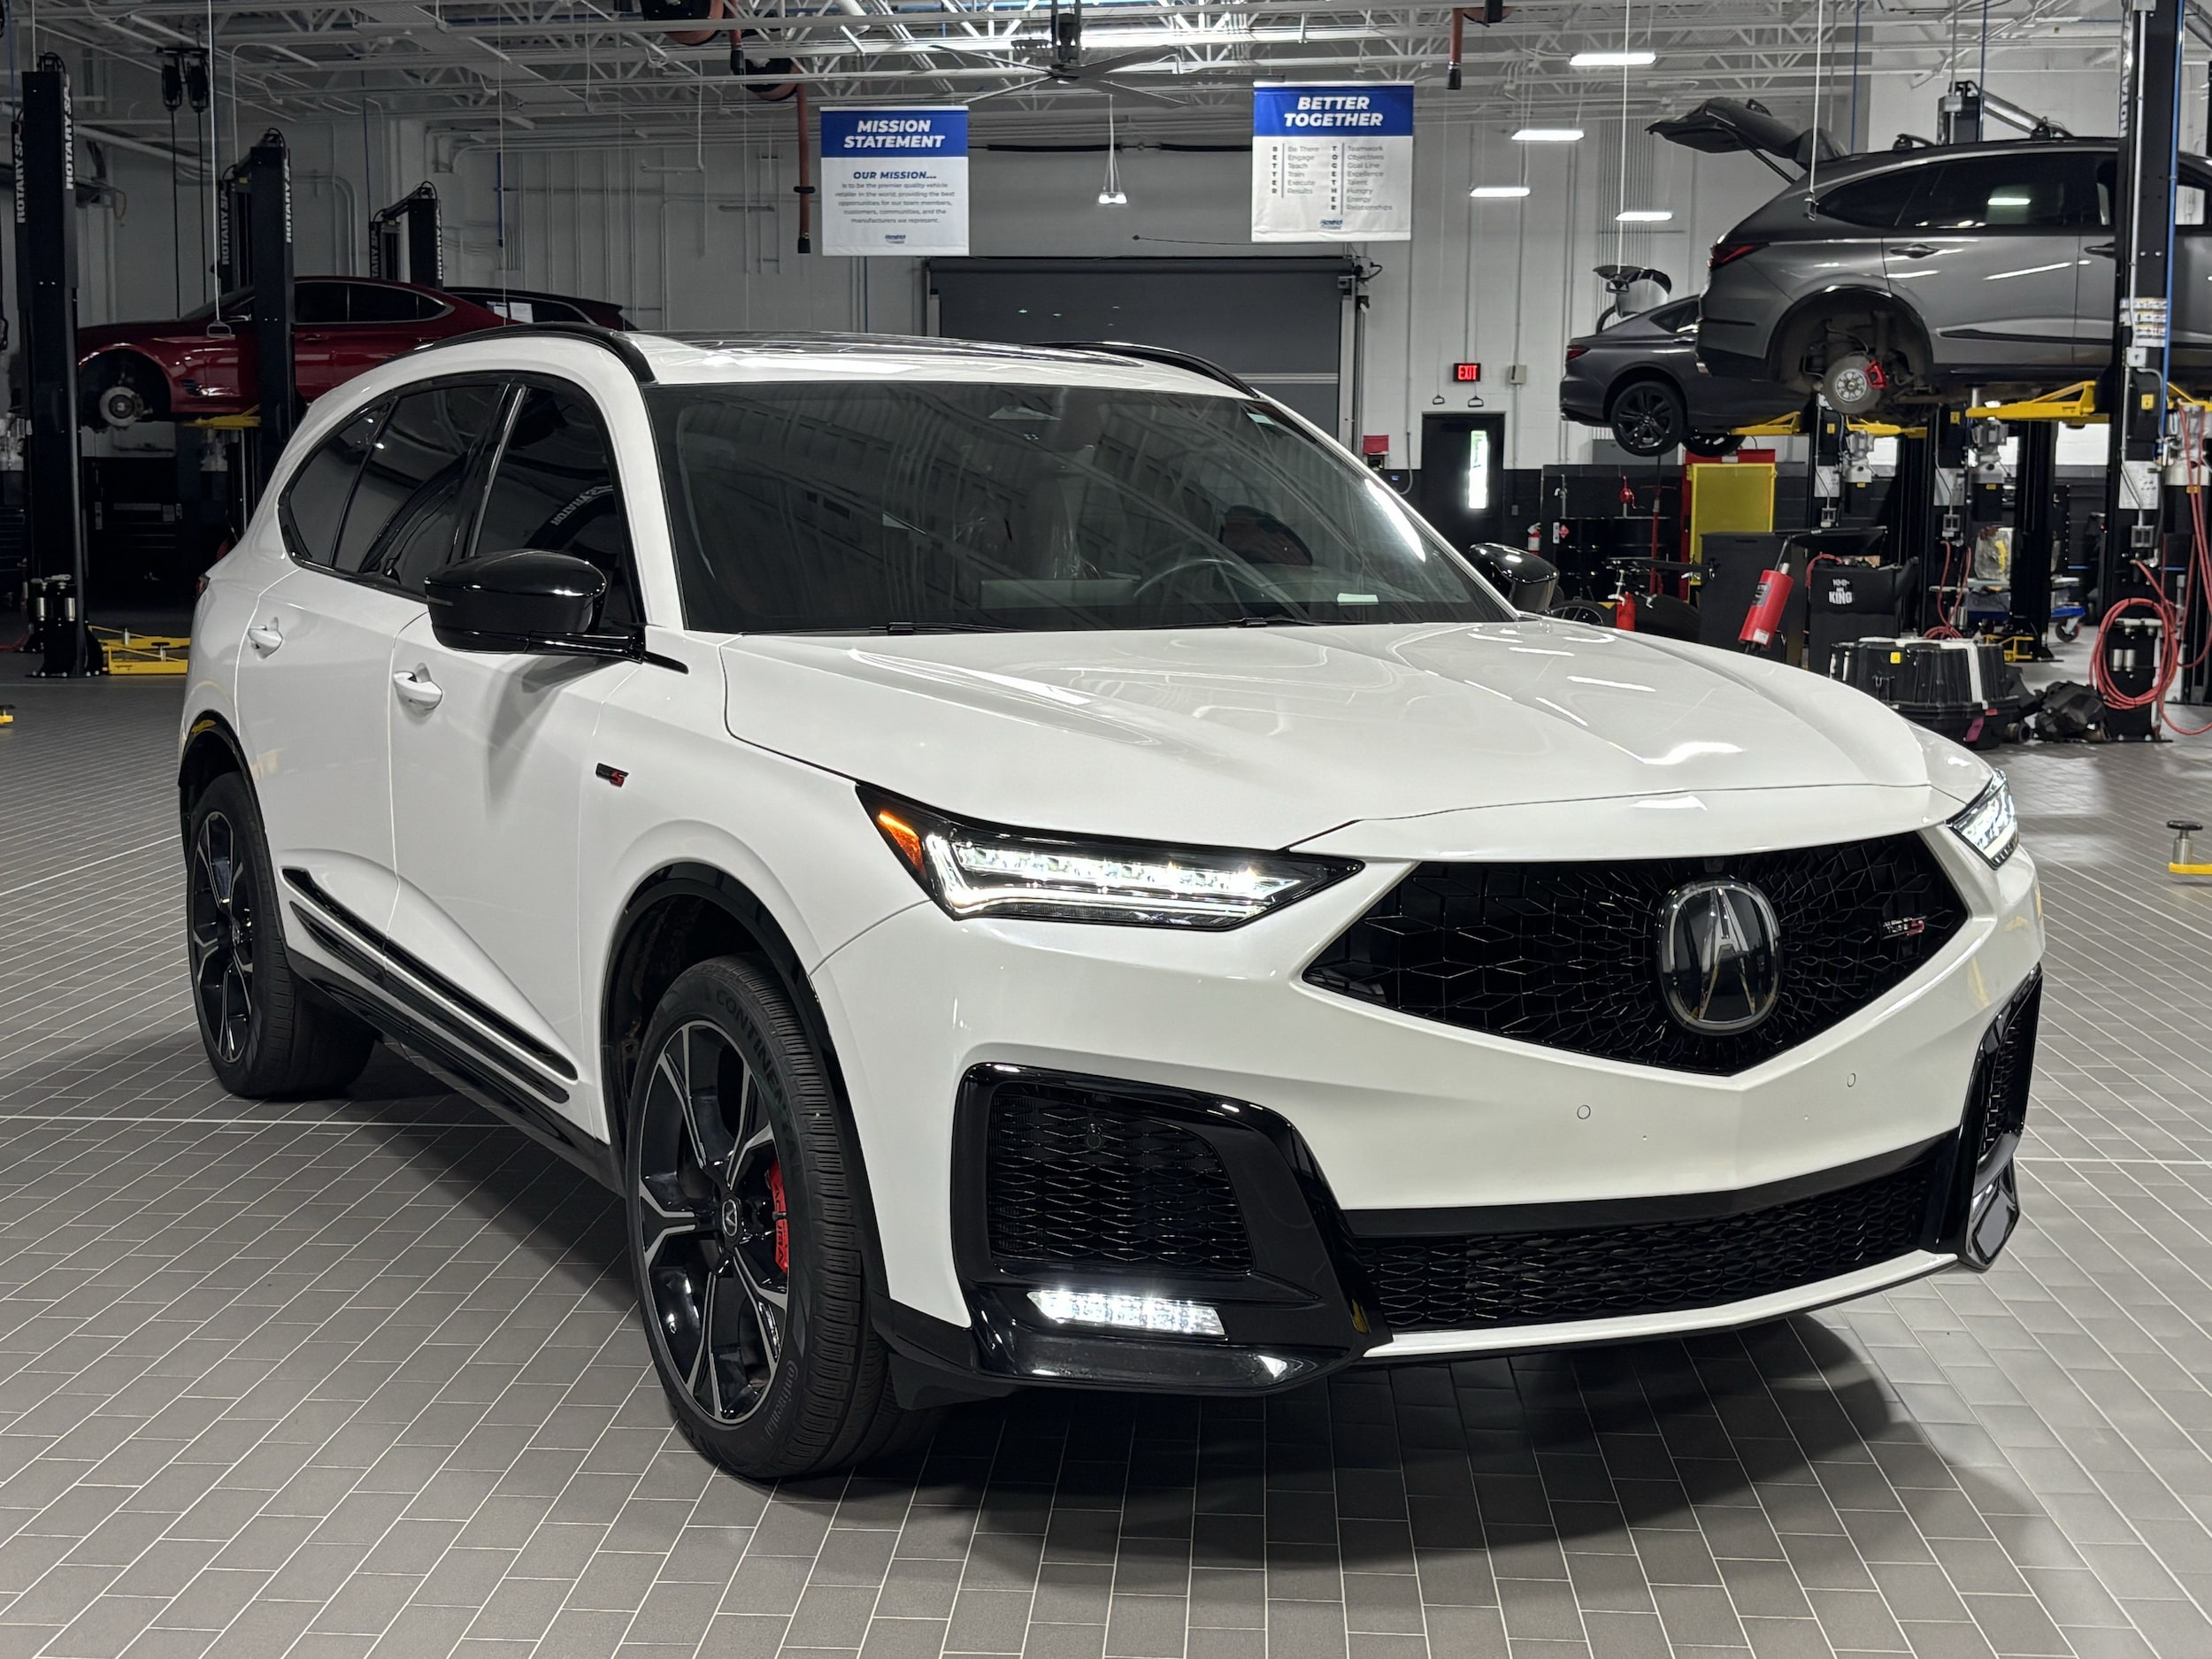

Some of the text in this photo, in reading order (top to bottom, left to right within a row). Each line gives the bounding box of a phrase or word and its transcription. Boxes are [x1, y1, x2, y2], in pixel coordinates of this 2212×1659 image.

[2119, 47, 2133, 137] ROTA
[1297, 96, 1371, 110] BETTER
[857, 120, 931, 133] MISSION
[1284, 113, 1384, 127] TOGETHER
[844, 135, 945, 149] STATEMENT
[65, 114, 73, 189] ROTARY
[15, 157, 26, 223] ROTARY
[1458, 365, 1478, 380] EXIT
[1829, 591, 1853, 604] KING
